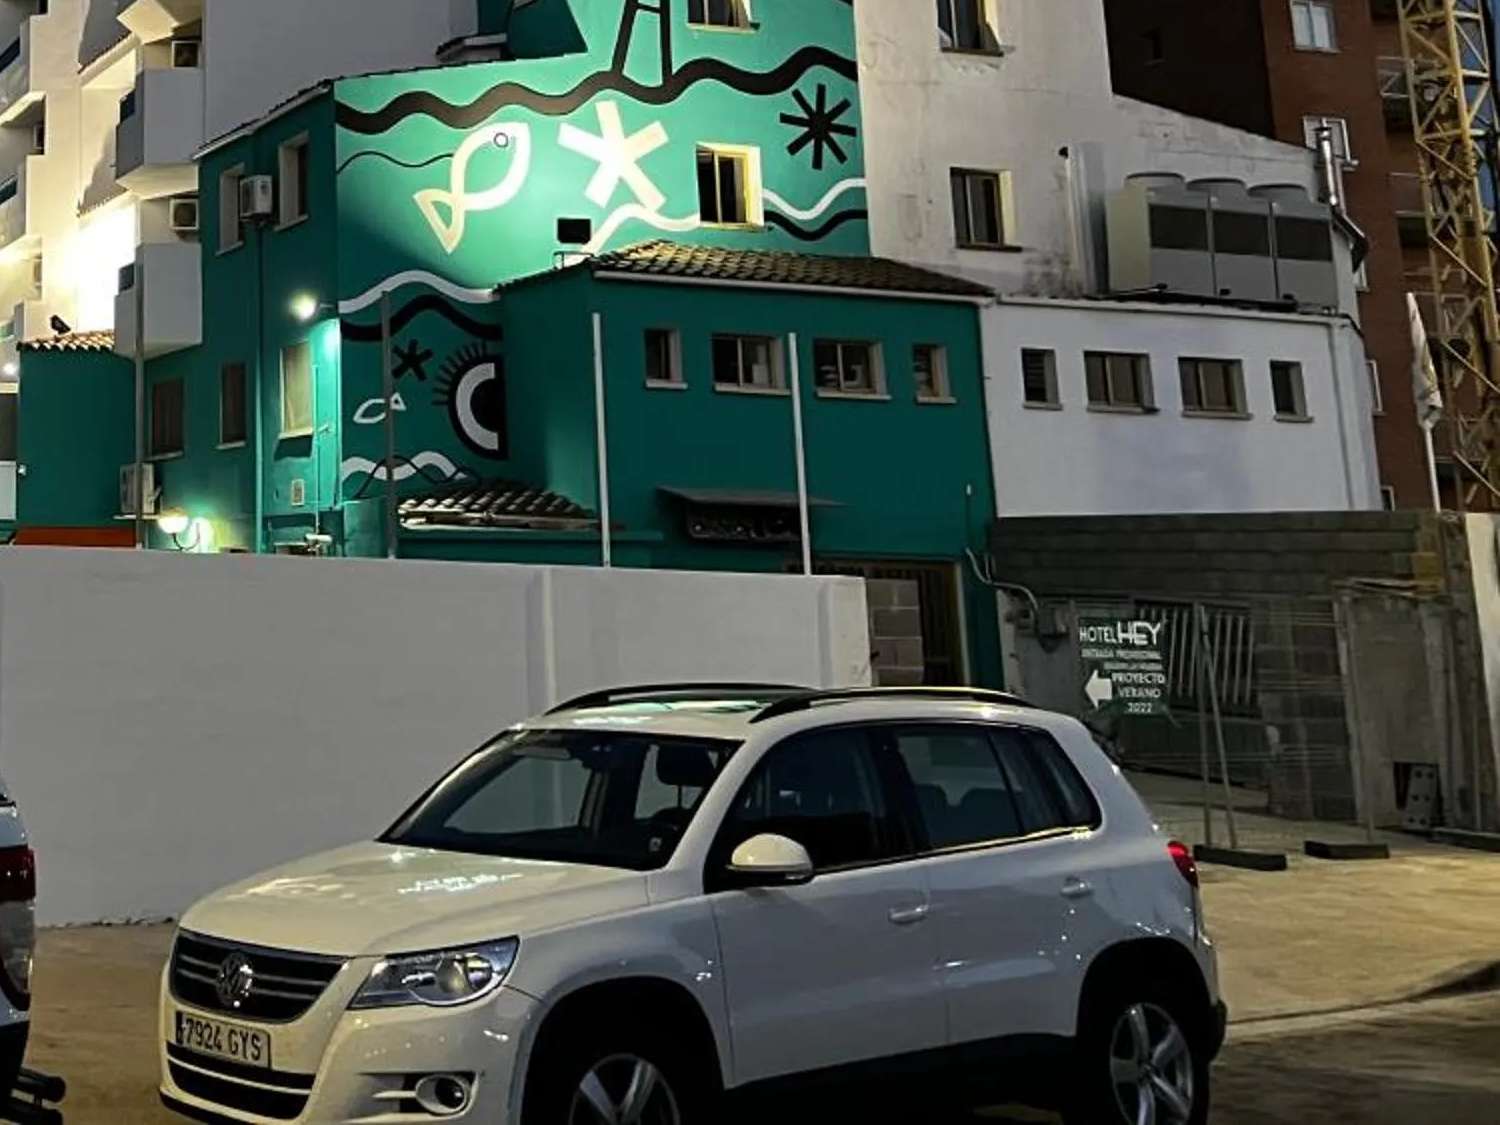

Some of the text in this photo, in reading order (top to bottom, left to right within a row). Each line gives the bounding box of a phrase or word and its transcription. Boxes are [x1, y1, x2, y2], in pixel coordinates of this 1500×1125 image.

[1079, 621, 1161, 645] HOTEL HEY
[1111, 672, 1166, 684] PROYECTO
[1119, 687, 1161, 699] VERANO
[185, 1018, 261, 1061] 7924 GYS
